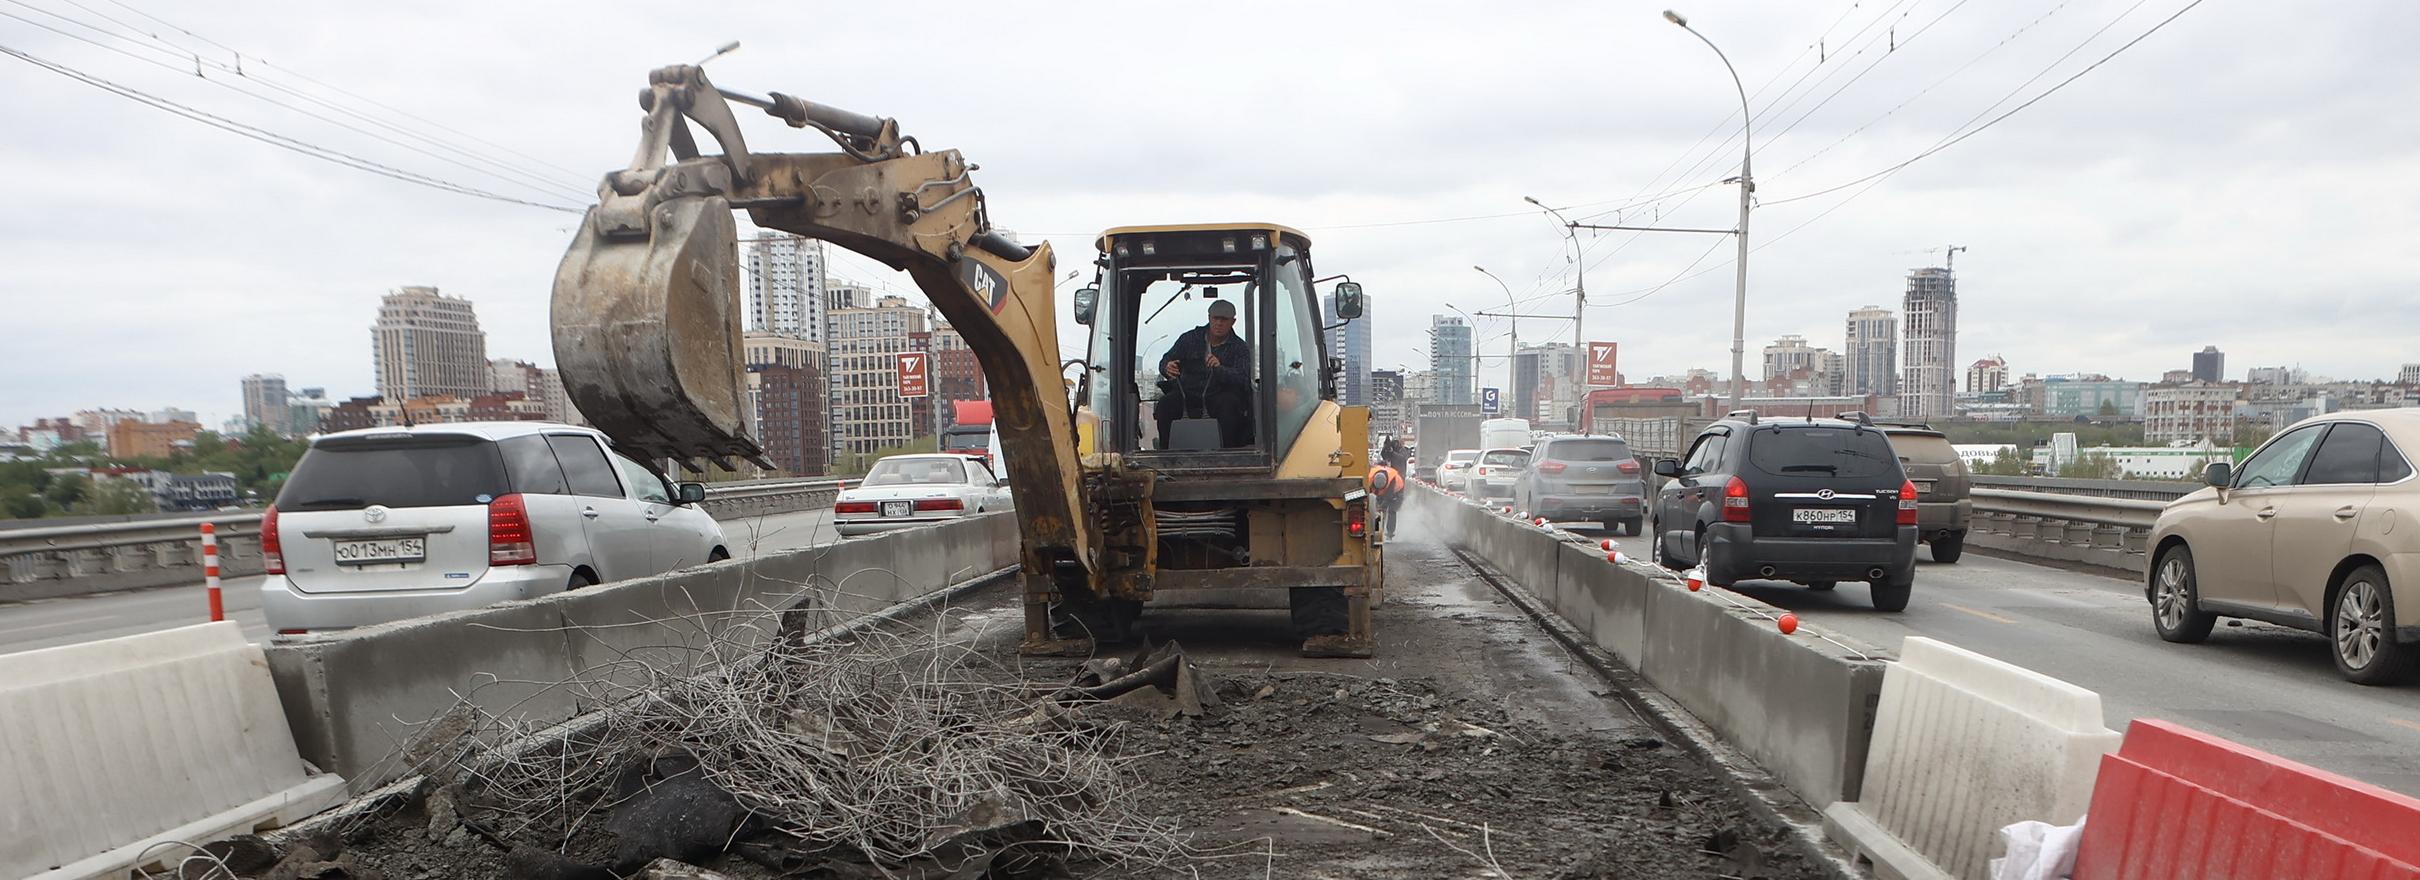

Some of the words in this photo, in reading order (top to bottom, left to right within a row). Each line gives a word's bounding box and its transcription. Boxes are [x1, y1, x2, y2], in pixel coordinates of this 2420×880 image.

[975, 263, 996, 306] CAT
[1796, 510, 1836, 521] К860НР
[1839, 510, 1853, 519] 154
[340, 543, 396, 558] О013МН
[399, 540, 422, 552] 154
